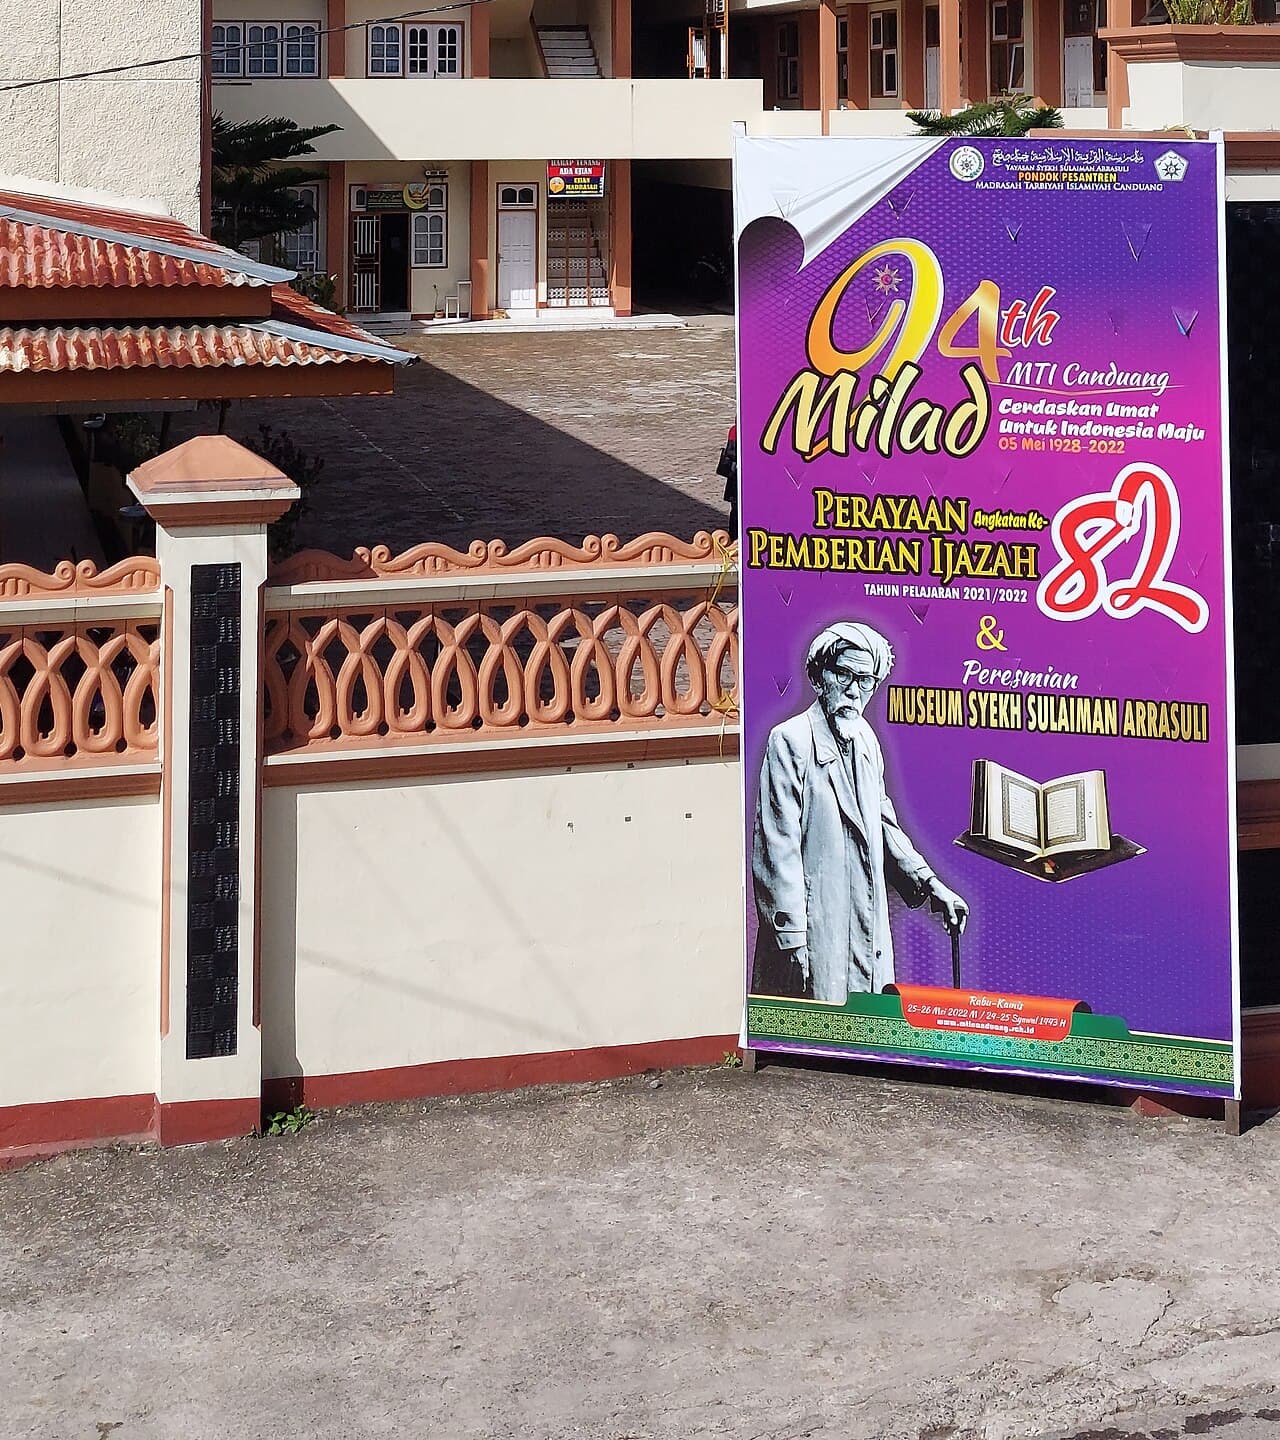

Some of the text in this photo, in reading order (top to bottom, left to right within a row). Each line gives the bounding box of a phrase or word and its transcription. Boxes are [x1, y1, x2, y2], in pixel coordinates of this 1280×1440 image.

[975, 181, 1163, 192] MADRASAH TARBIYAH ISLAMIYAH CANDUANG
[1018, 172, 1117, 183] PONDOK PESANTREN
[1006, 361, 1170, 397] MTI Canduang
[761, 363, 990, 457] Milad
[998, 398, 1160, 418] Cerdaskan Umat
[998, 418, 1206, 443] Untuk Indonesia Maju
[998, 436, 1126, 454] 05 Mei 1928-2022
[814, 489, 969, 533] PERAYAAN
[972, 509, 1049, 531] Angkatan Ke-
[748, 529, 1039, 584] PEMBERIAN IJAZAH
[1038, 463, 1209, 633] 82
[864, 584, 1029, 604] TAHUN PELAJARAN 2021/2022
[975, 615, 1008, 652] &
[961, 660, 1080, 691] Peresmian
[887, 687, 1208, 742] MUSEUM SYEKH SULAIMAN ARRASULI
[907, 1003, 932, 1014] 25-26
[947, 1007, 969, 1018] 2022
[1059, 1018, 1067, 1028] H
[969, 995, 1024, 1011] Rabu-Kamis
